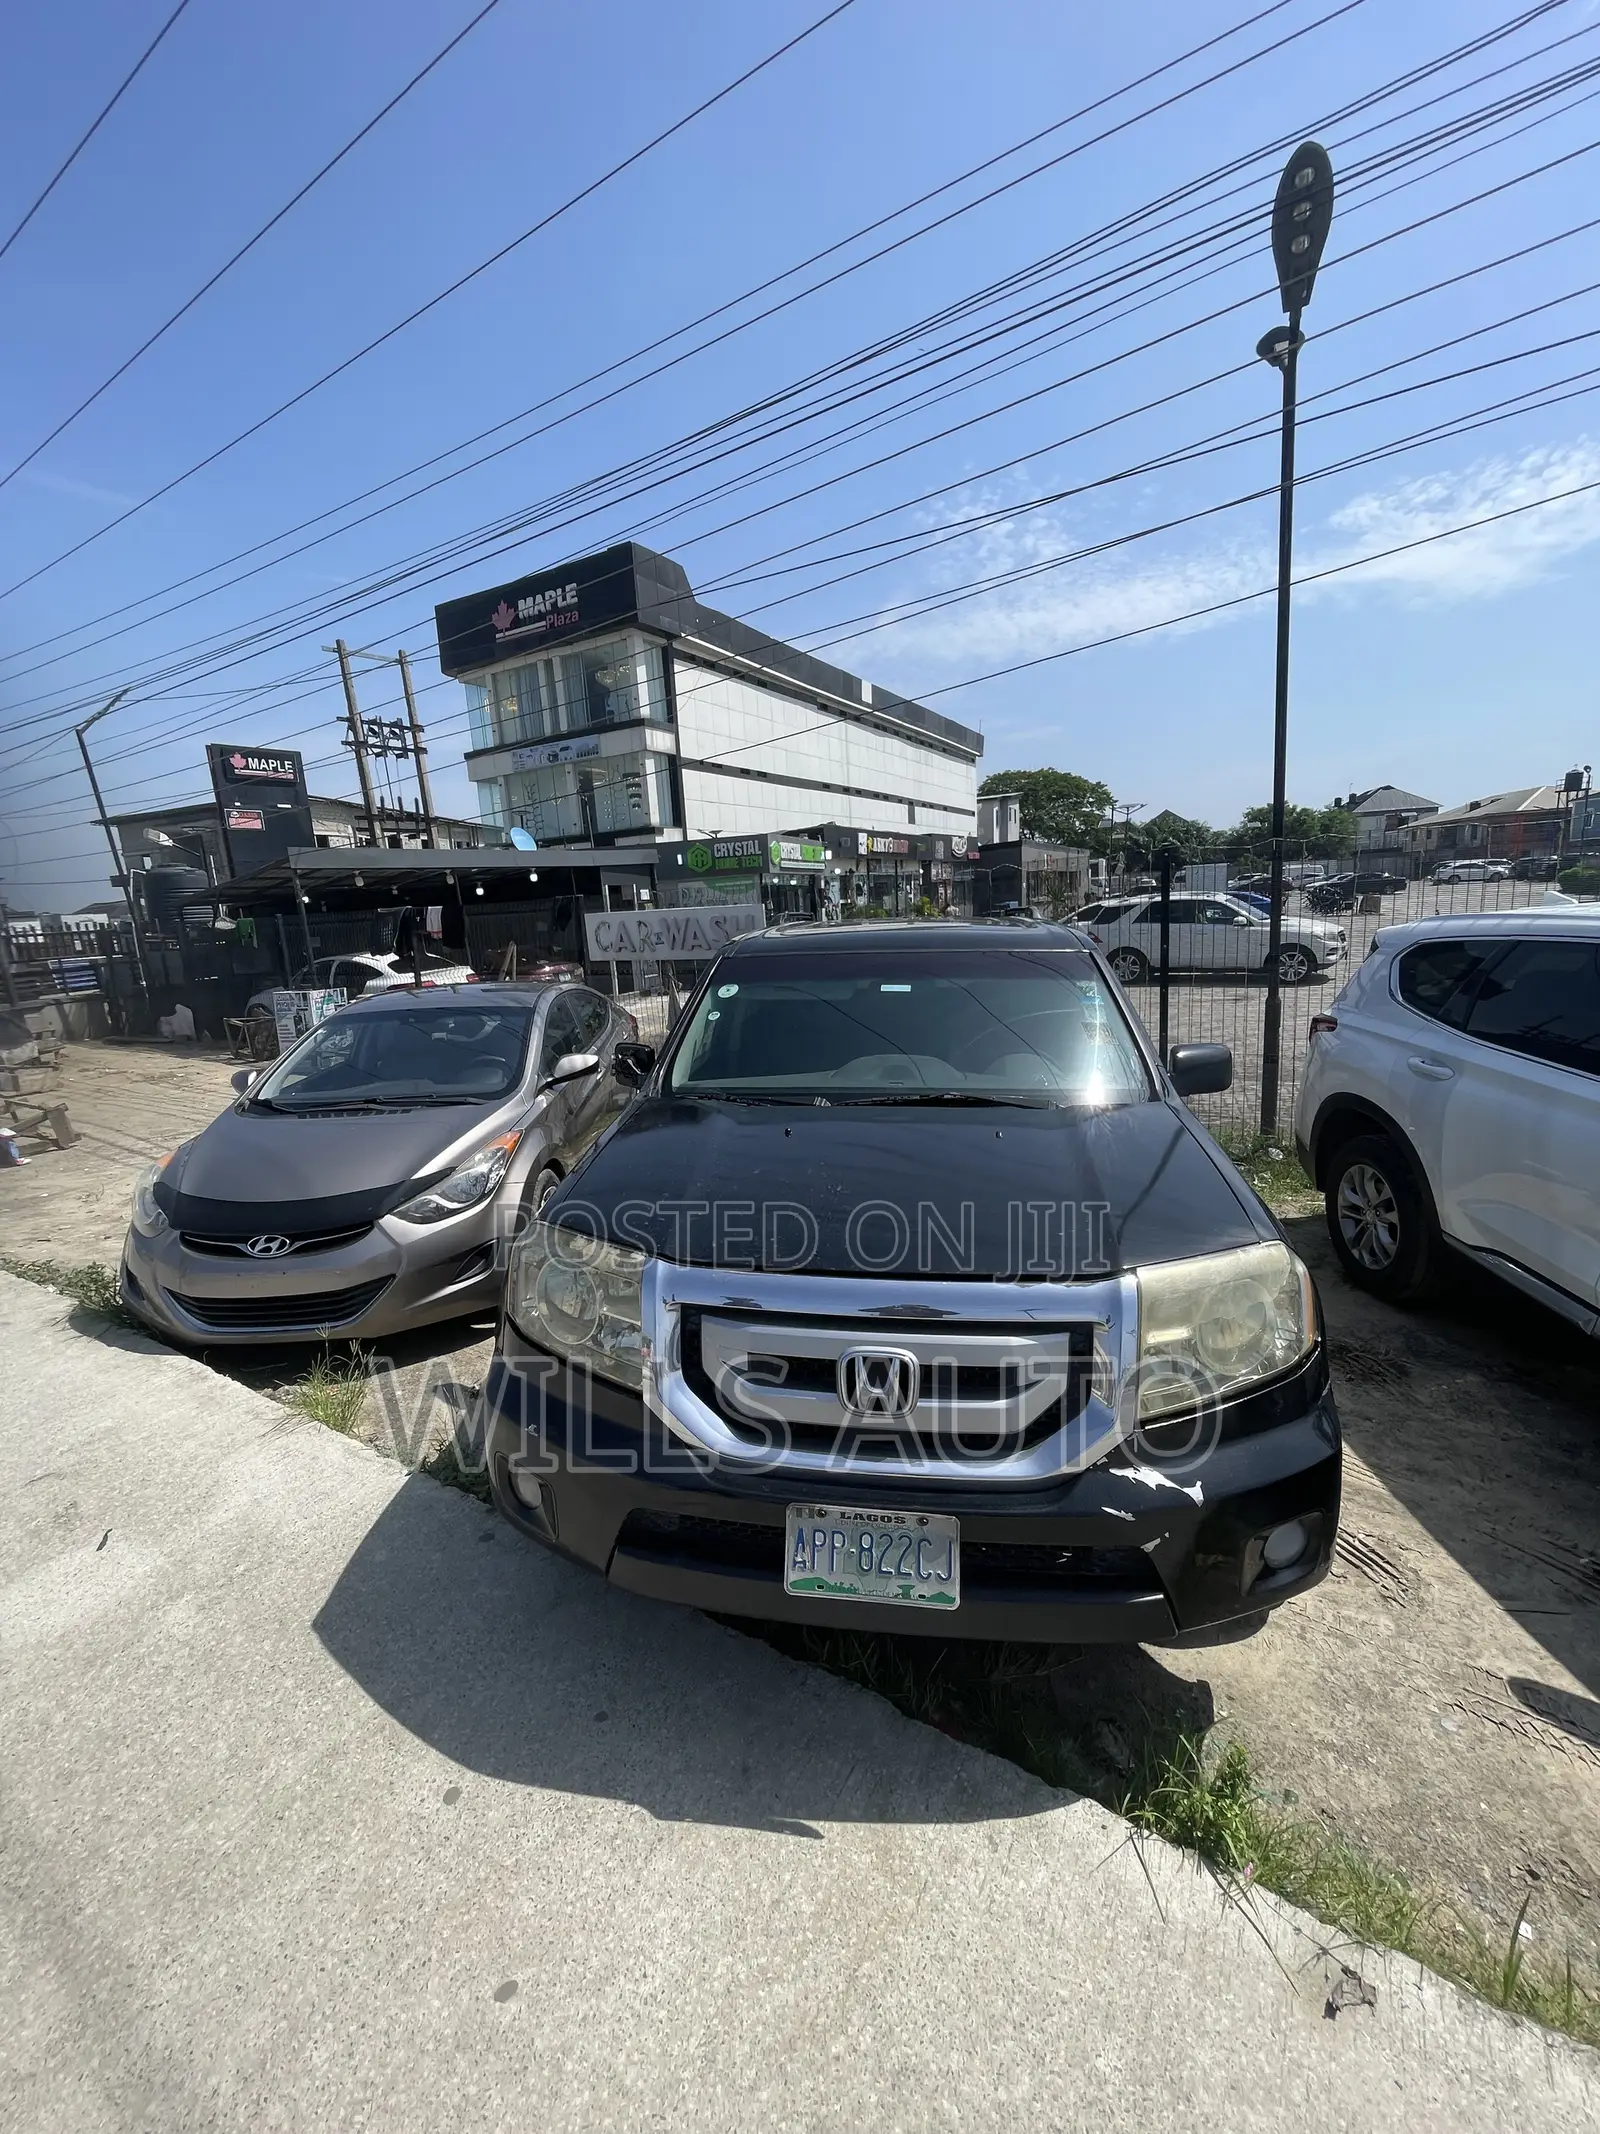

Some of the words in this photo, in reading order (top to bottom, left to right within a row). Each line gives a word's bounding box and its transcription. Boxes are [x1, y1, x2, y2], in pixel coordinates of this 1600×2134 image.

[518, 582, 579, 620] MAPLE
[546, 610, 579, 630] Plaza
[247, 757, 294, 773] MAPLE
[713, 840, 762, 858] CRYSTAL
[595, 920, 655, 953] CAR
[840, 1511, 906, 1525] LAGOS
[792, 1527, 952, 1582] APP-822CJ
